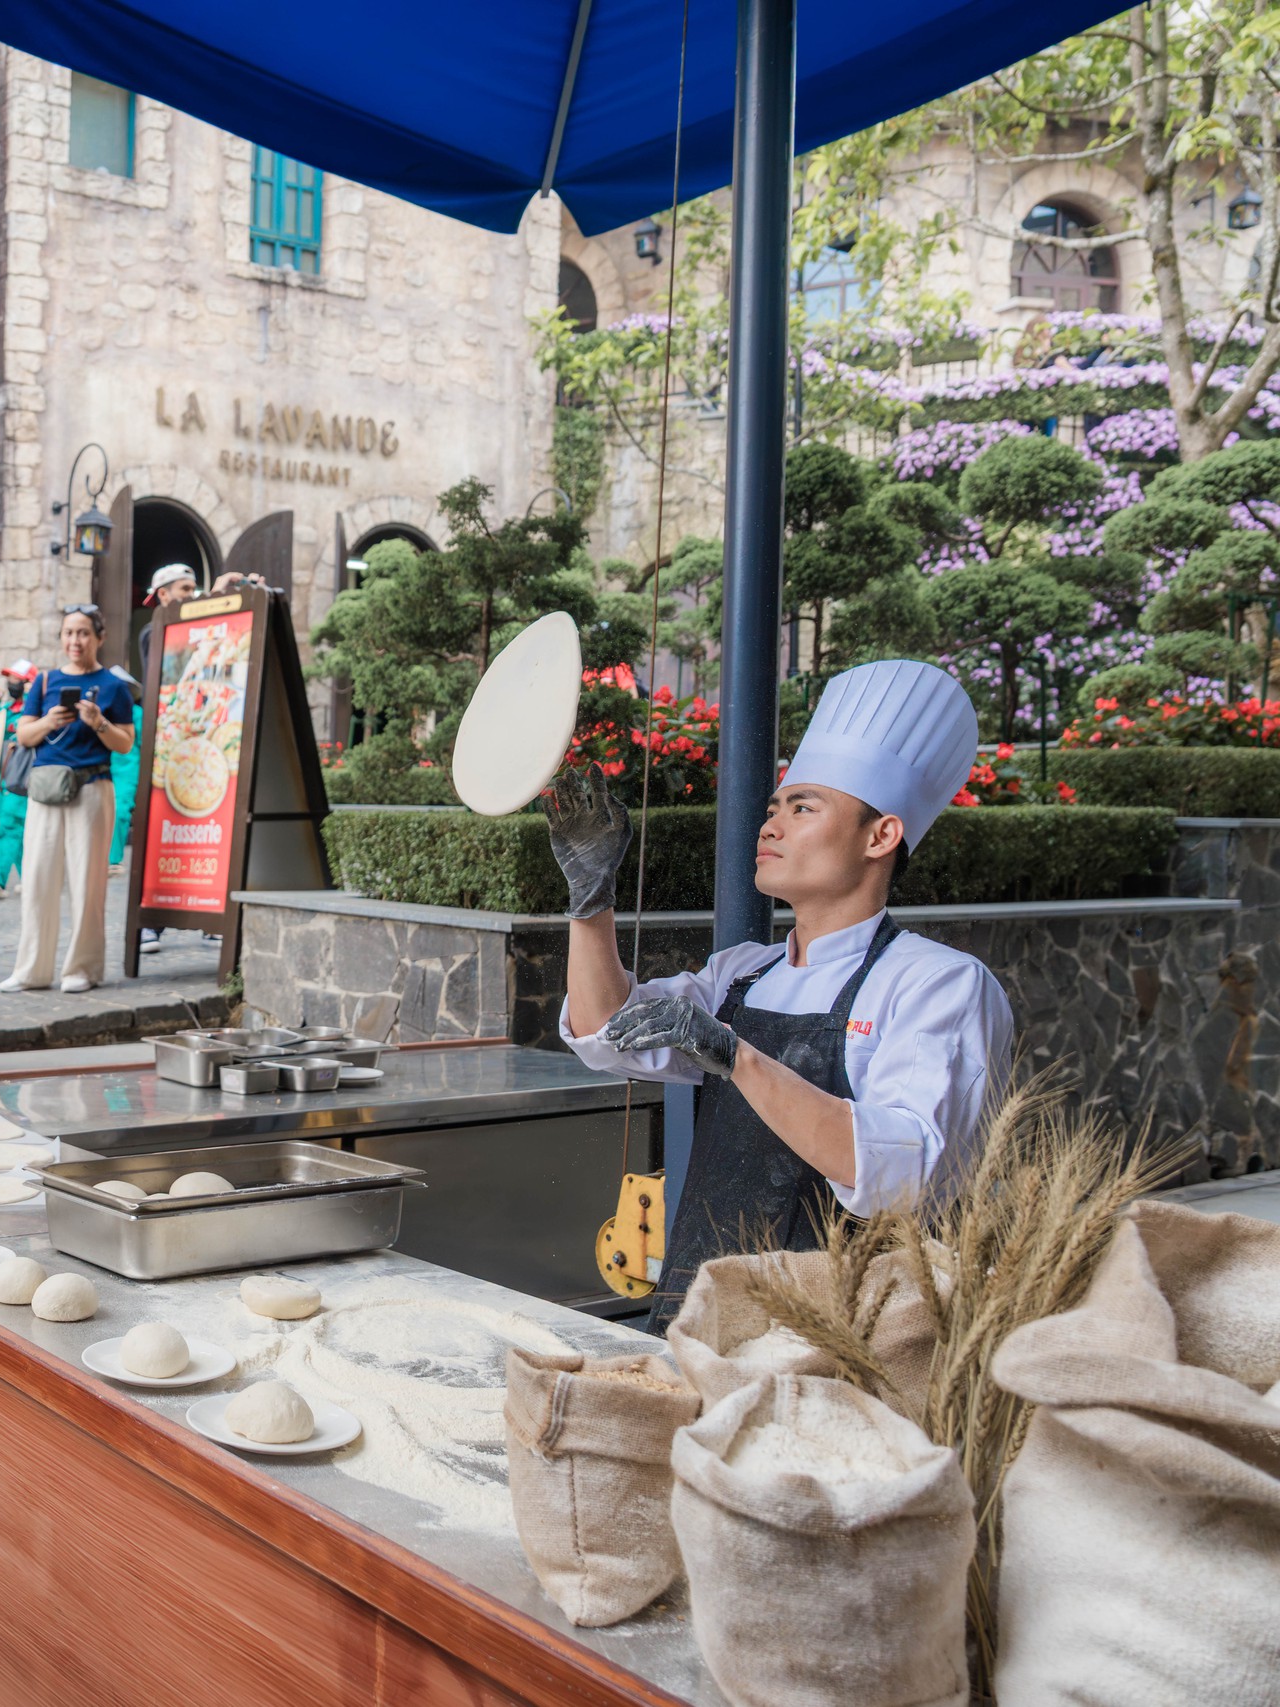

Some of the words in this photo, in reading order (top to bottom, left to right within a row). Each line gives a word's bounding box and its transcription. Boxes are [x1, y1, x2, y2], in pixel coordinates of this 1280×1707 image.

[155, 386, 206, 433] LA
[232, 398, 399, 458] LAVANDE
[219, 449, 351, 488] RESTAURANT
[160, 818, 223, 845] Brasserie
[158, 857, 181, 874] 9:00
[189, 857, 218, 876] 16:30
